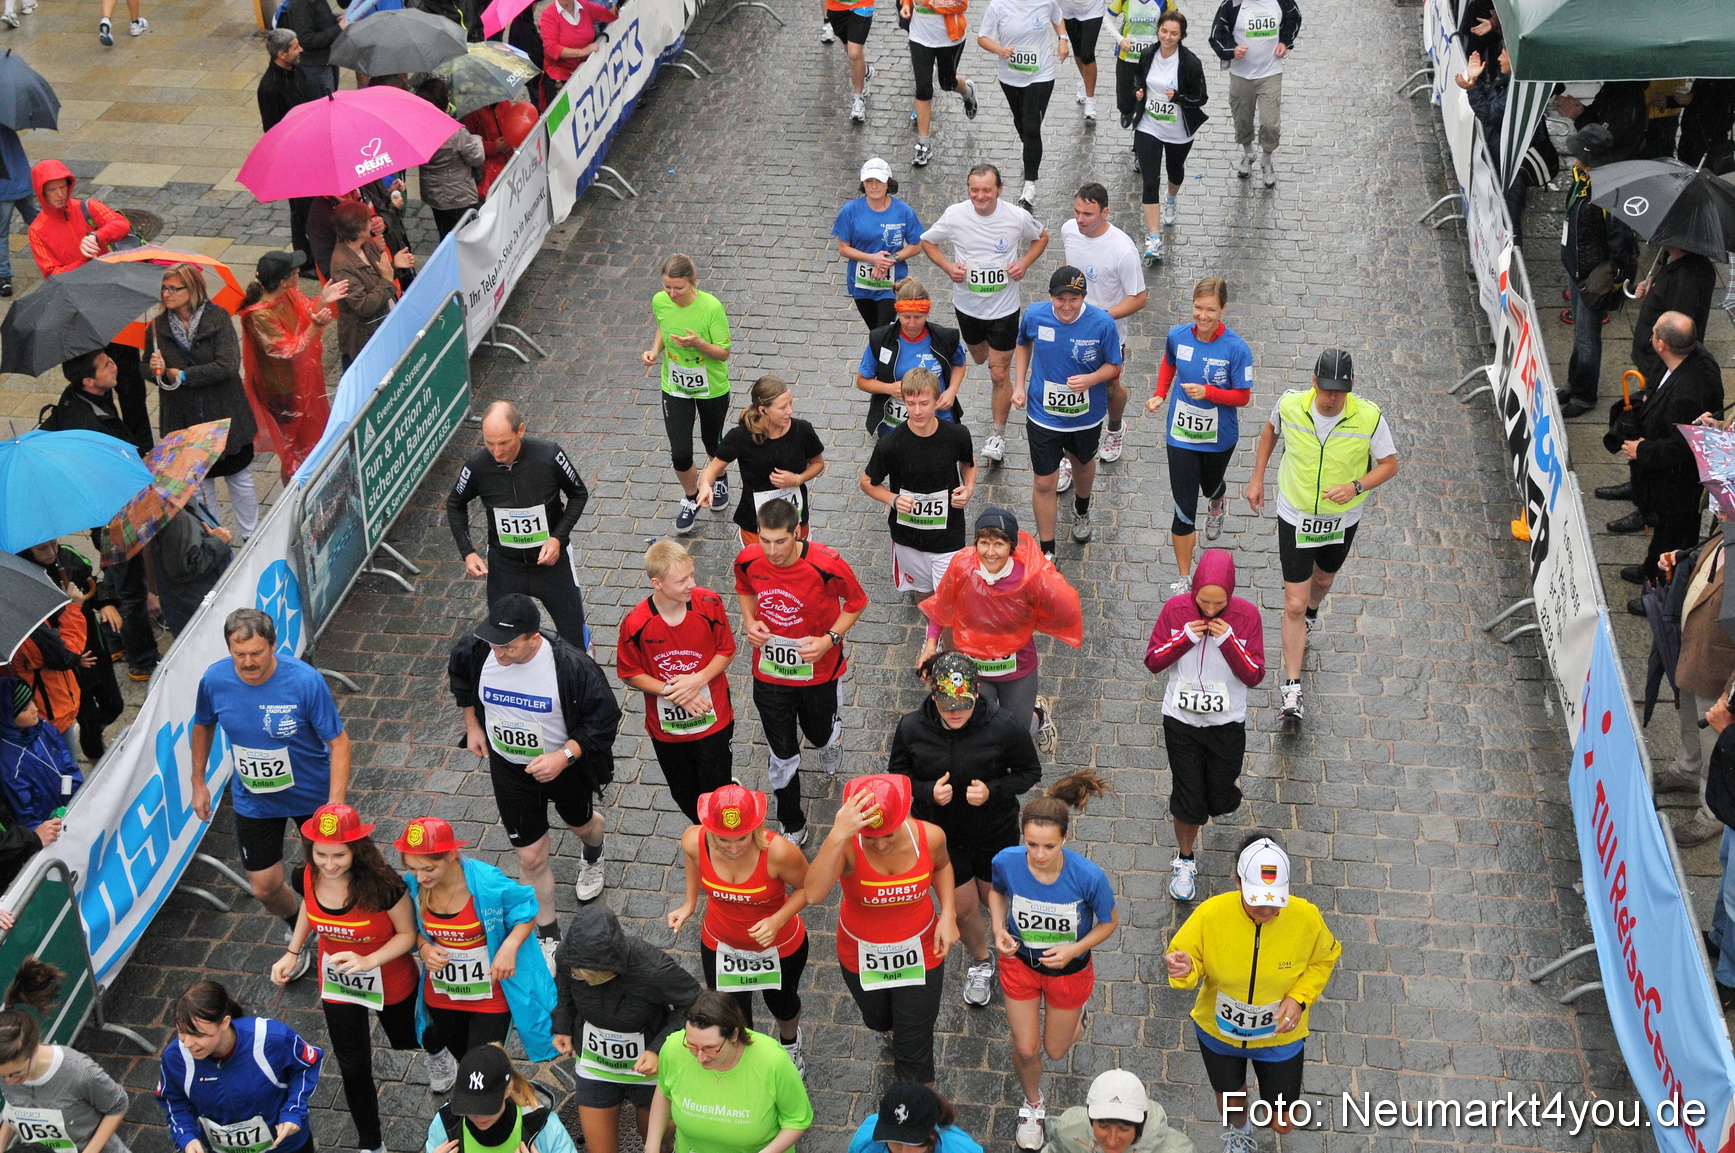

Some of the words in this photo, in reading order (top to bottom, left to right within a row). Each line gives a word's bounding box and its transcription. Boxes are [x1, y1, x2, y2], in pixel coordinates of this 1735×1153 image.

[1248, 17, 1276, 31] 5046
[1009, 52, 1037, 65] 5099
[571, 17, 643, 159] BOCK
[1148, 99, 1175, 115] 5042
[859, 265, 891, 280] 514
[970, 269, 1004, 284] 5106
[469, 292, 482, 309] Ihr
[672, 370, 704, 388] 5129
[376, 352, 428, 425] Event-Leit-Systeme
[1048, 391, 1086, 407] 5204
[887, 400, 908, 419] 514
[1177, 411, 1214, 432] 5157
[364, 449, 383, 487] Fun
[384, 437, 393, 458] &
[393, 403, 423, 443] Action
[422, 385, 433, 404] in
[368, 451, 406, 512] sicheren
[405, 396, 442, 457] Bahnen!
[391, 480, 410, 512] Service
[410, 461, 424, 489] Line:
[437, 417, 451, 442] 6352
[905, 500, 943, 517] 045
[501, 516, 541, 534] 5131
[1301, 517, 1342, 533] 5097
[513, 536, 534, 544] Dieter
[1306, 534, 1335, 543] Reinhard
[765, 645, 806, 665] 506
[773, 664, 798, 675] Patrick
[975, 662, 1007, 672] argarete
[492, 693, 547, 710] STAEDTLER
[1177, 691, 1224, 712] 5133
[671, 717, 707, 729] Ferdinand
[493, 725, 539, 748] 5088
[505, 746, 527, 755] Xaver
[239, 757, 286, 778] 5152
[1592, 779, 1618, 880] TUI
[712, 891, 751, 903] DURST
[878, 884, 918, 896] DURST
[1018, 911, 1071, 932] 5208
[317, 925, 355, 937] DURST
[427, 929, 465, 938] DURST
[866, 949, 918, 970] 5100
[327, 965, 375, 991] 5047
[740, 976, 758, 985] Lisa
[883, 973, 902, 981] Anja
[446, 984, 471, 994] Judith
[1221, 1003, 1273, 1028] 3418
[588, 1031, 638, 1060] 5190
[596, 1056, 628, 1069] Claudia
[45, 1140, 61, 1149] ina
